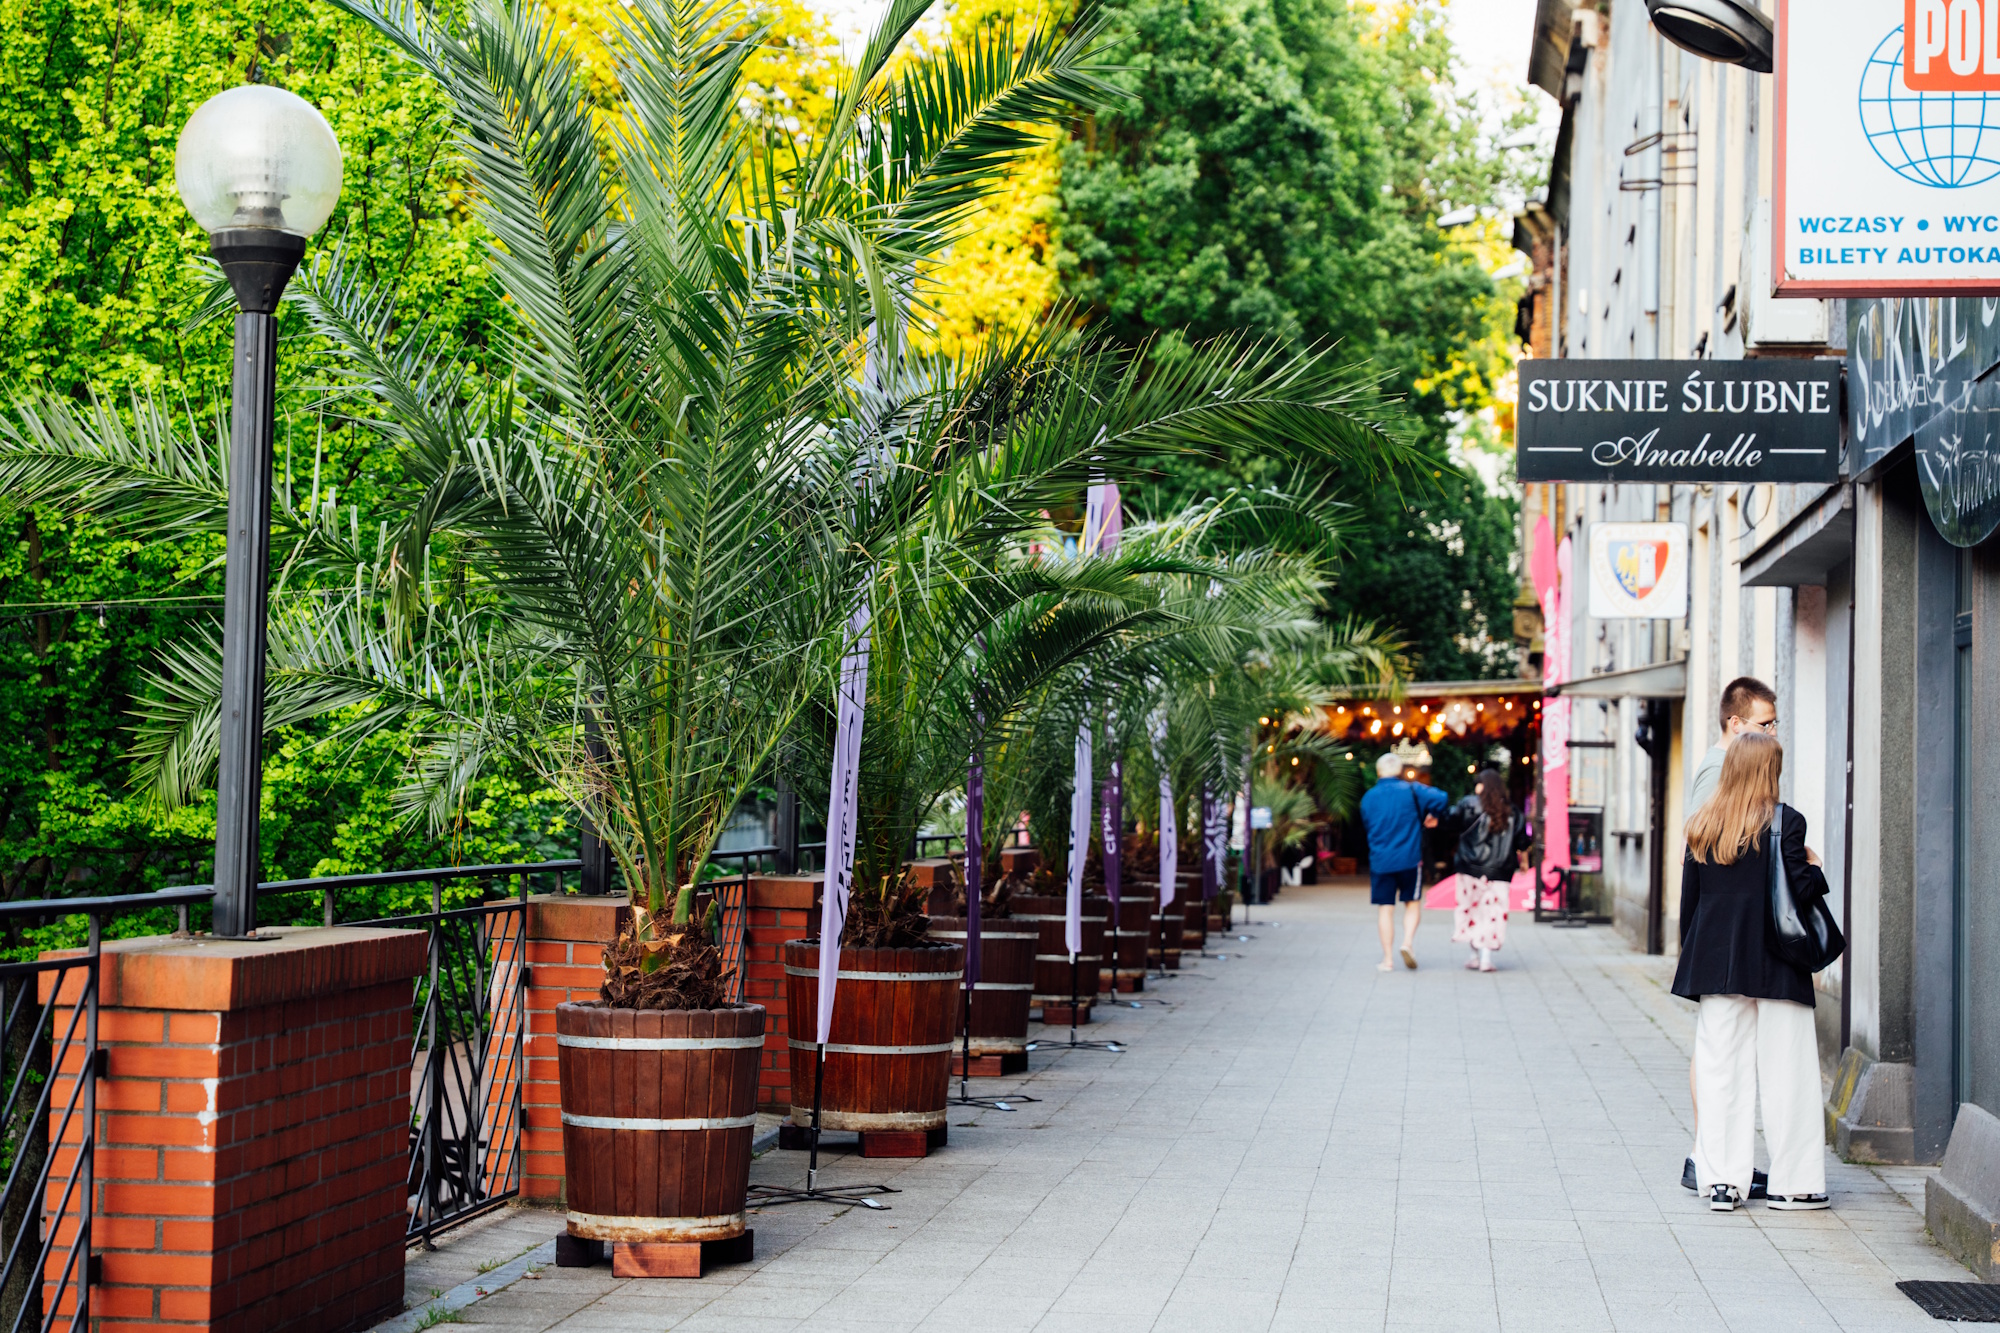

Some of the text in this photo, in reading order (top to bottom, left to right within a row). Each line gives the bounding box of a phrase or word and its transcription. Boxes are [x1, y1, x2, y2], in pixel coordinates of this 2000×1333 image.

[1799, 215, 1999, 233] WCZASY WYC
[1799, 246, 2000, 264] BILETY AUTOKA
[1527, 379, 1669, 413] SUKNIE
[1681, 370, 1831, 414] ŚLUBNE
[1591, 427, 1763, 467] Anabelle
